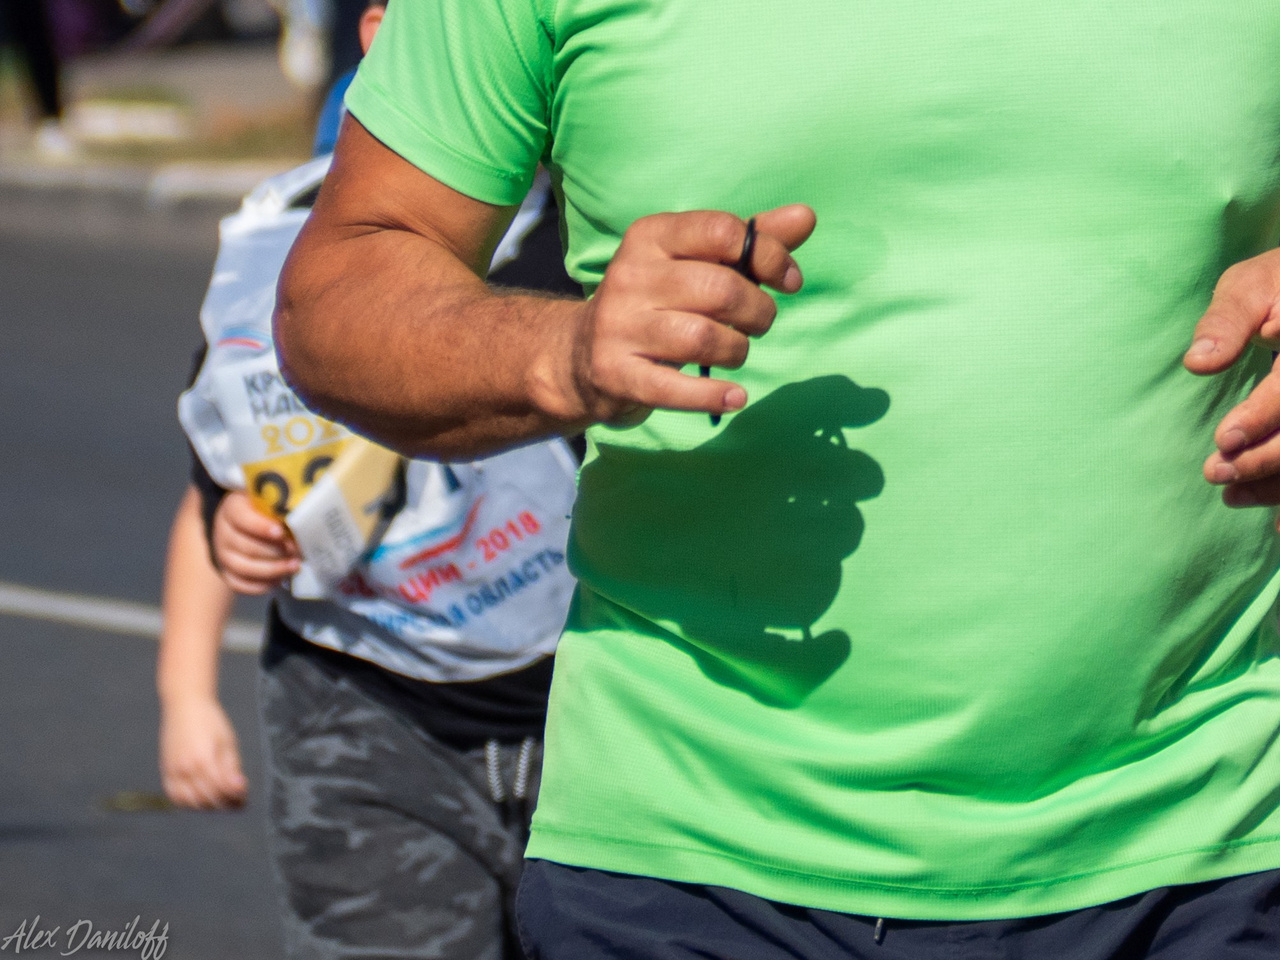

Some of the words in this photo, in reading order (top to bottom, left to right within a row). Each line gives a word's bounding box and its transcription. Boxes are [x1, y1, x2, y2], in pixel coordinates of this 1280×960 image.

[385, 563, 464, 604] ЦИИ
[475, 510, 542, 563] 2018
[465, 548, 565, 616] ОБЛАСТЬ
